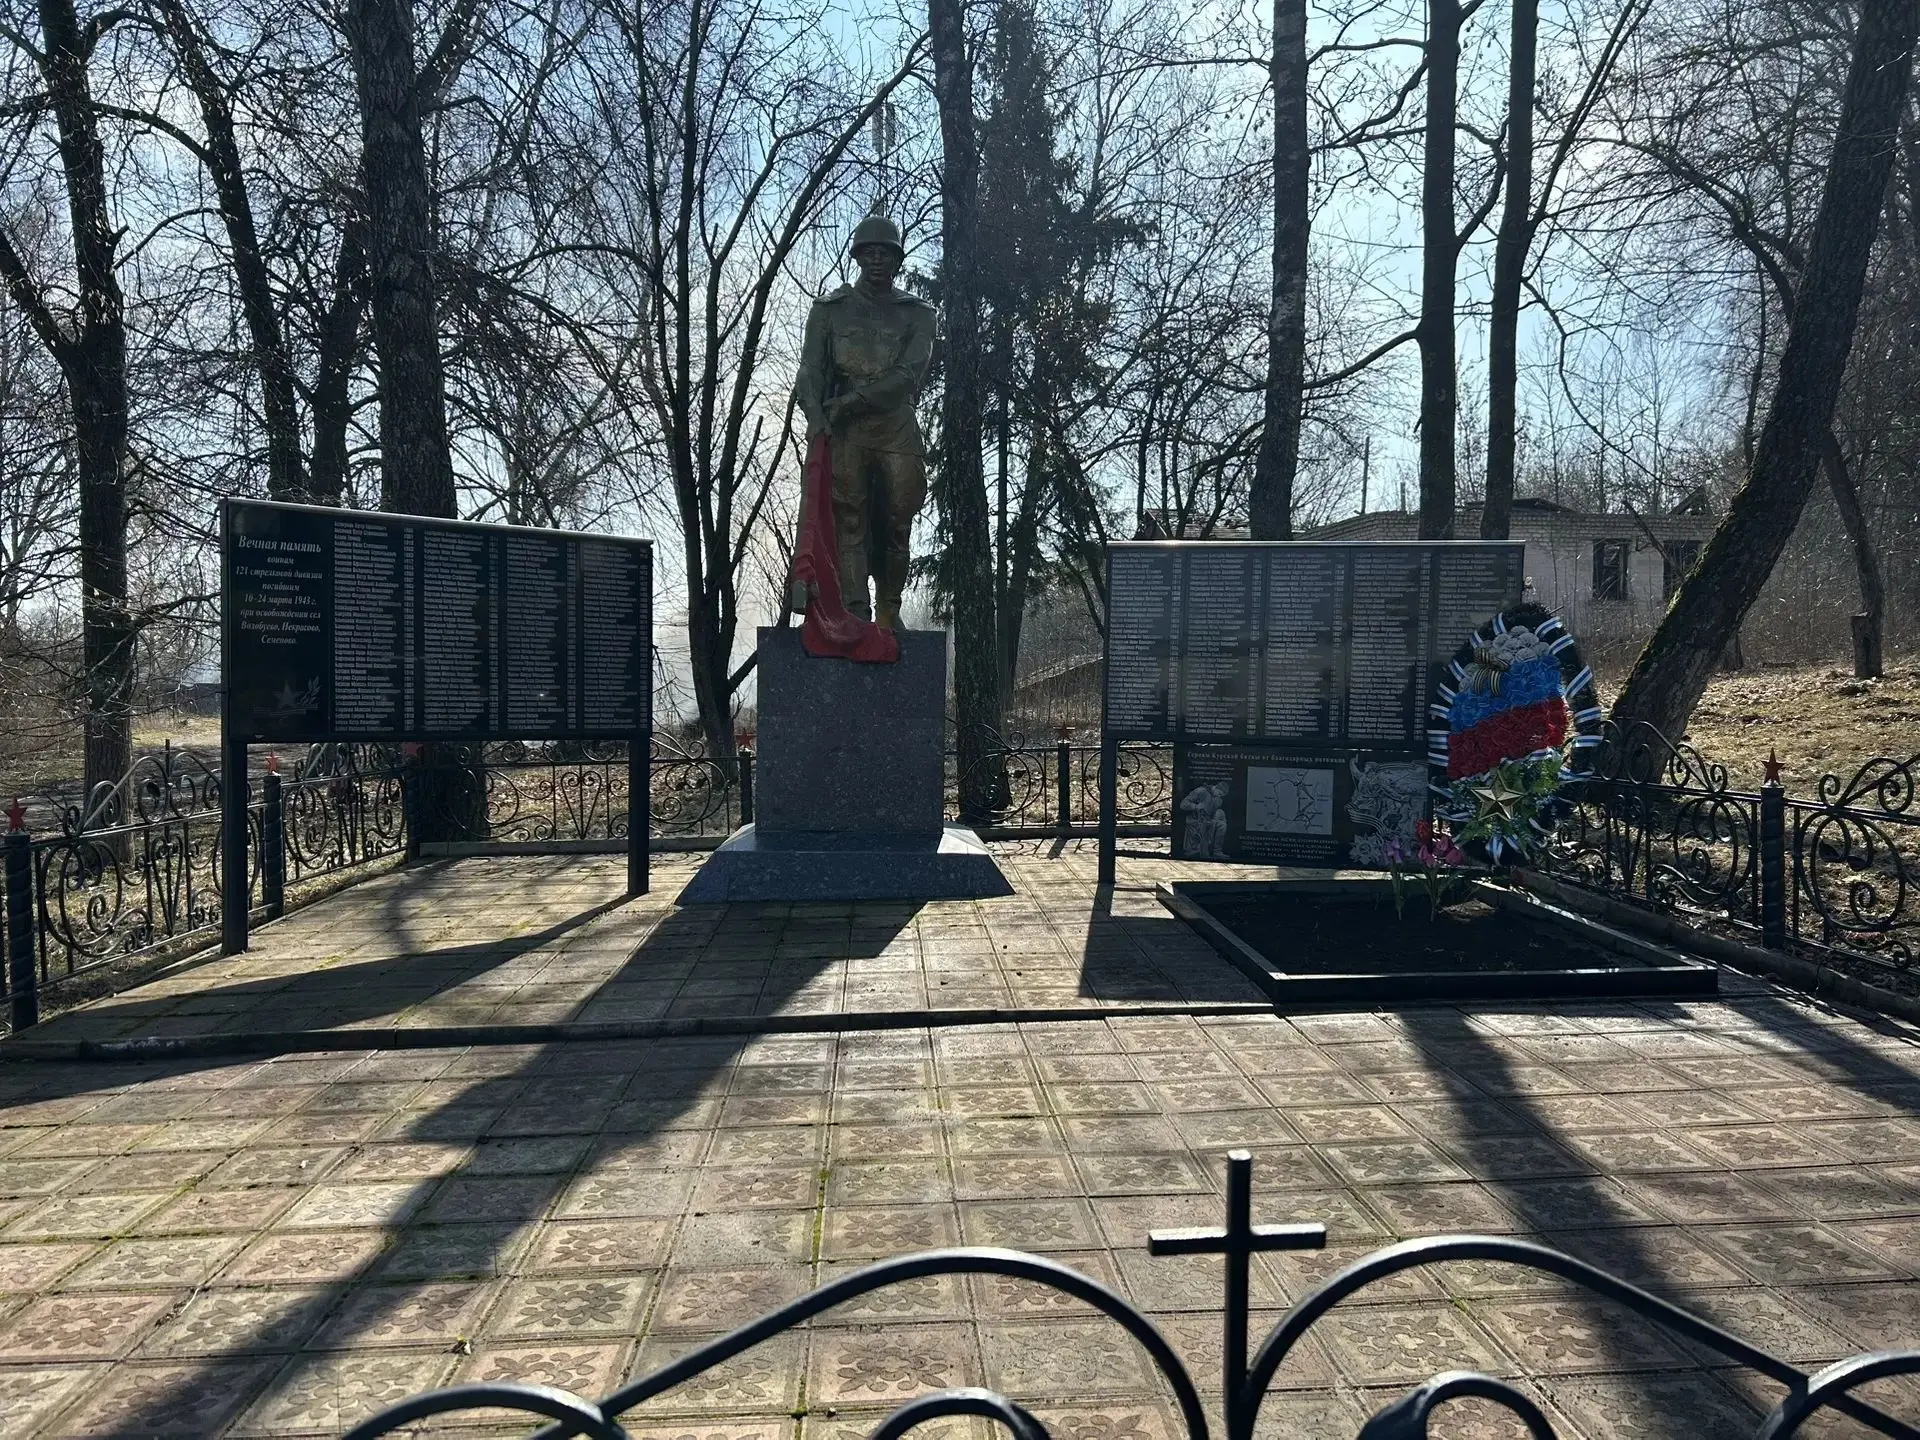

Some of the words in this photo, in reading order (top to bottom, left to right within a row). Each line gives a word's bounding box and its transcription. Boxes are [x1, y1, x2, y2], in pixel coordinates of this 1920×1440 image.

[238, 535, 277, 550] Вечная
[280, 541, 322, 553] память
[235, 565, 249, 575] 121
[294, 595, 311, 605] 1943
